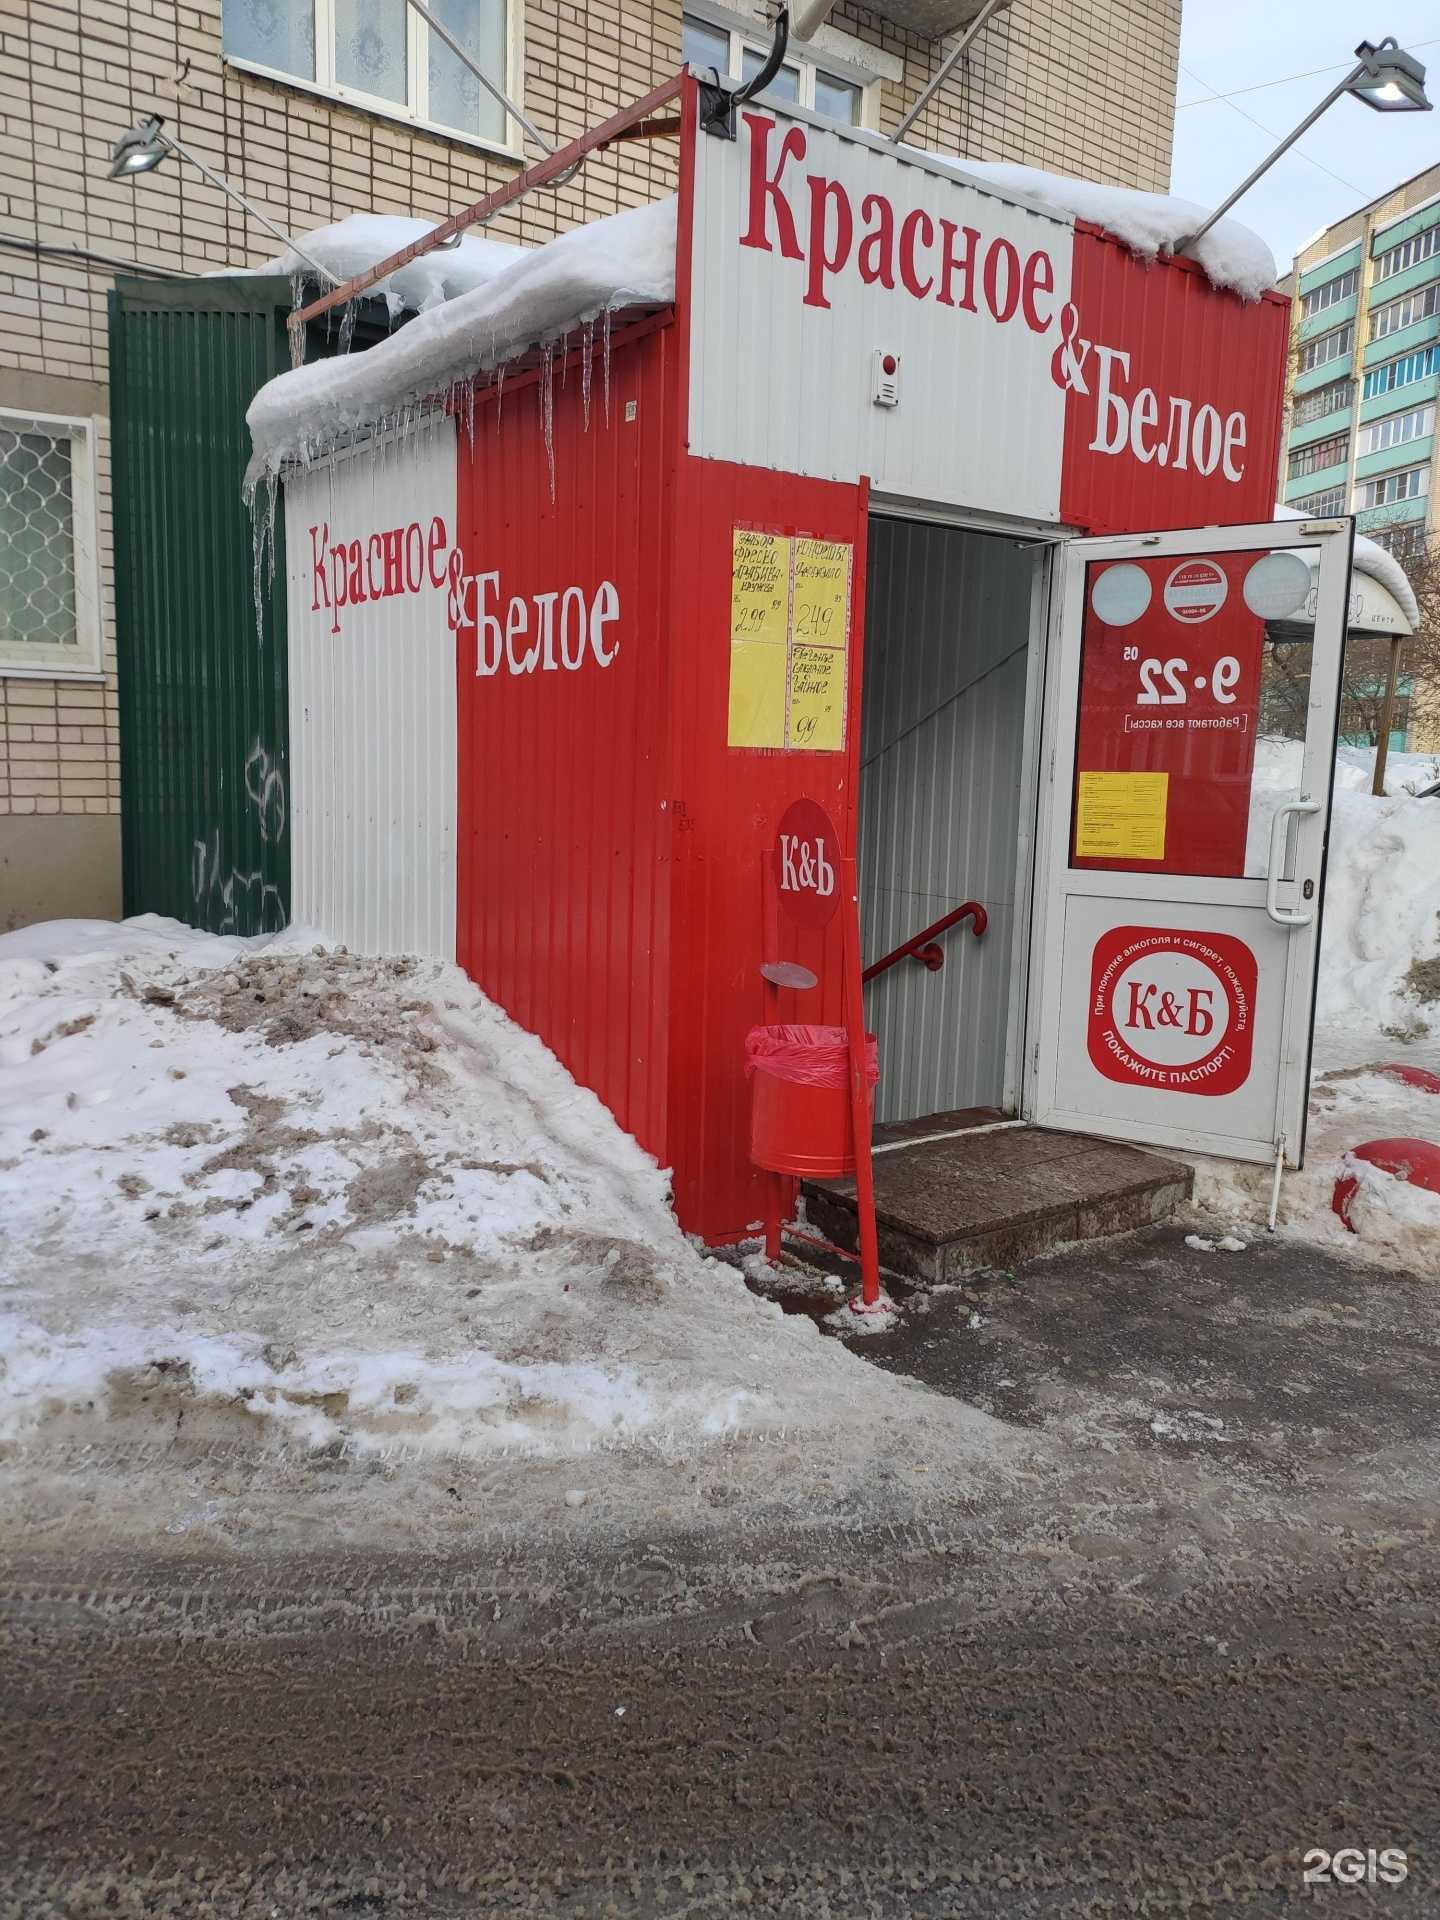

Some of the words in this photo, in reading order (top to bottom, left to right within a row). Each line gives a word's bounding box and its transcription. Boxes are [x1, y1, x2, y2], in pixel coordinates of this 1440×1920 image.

[739, 112, 1054, 333] Красное
[1088, 344, 1247, 482] Белое
[308, 516, 447, 633] Красное
[475, 570, 620, 677] Белое
[797, 604, 834, 635] 249
[1123, 936, 1171, 957] алкоголя
[1174, 937, 1181, 945] и
[1183, 938, 1223, 967] сигарет,
[1099, 953, 1124, 995] покупке
[1095, 994, 1105, 1016] При
[1124, 982, 1214, 1037] К&Б
[1223, 964, 1249, 1032] пожалуйста,
[1102, 1030, 1167, 1083] ПОКАЖИТЕ
[1170, 1045, 1236, 1084] ПАСПОРТ!
